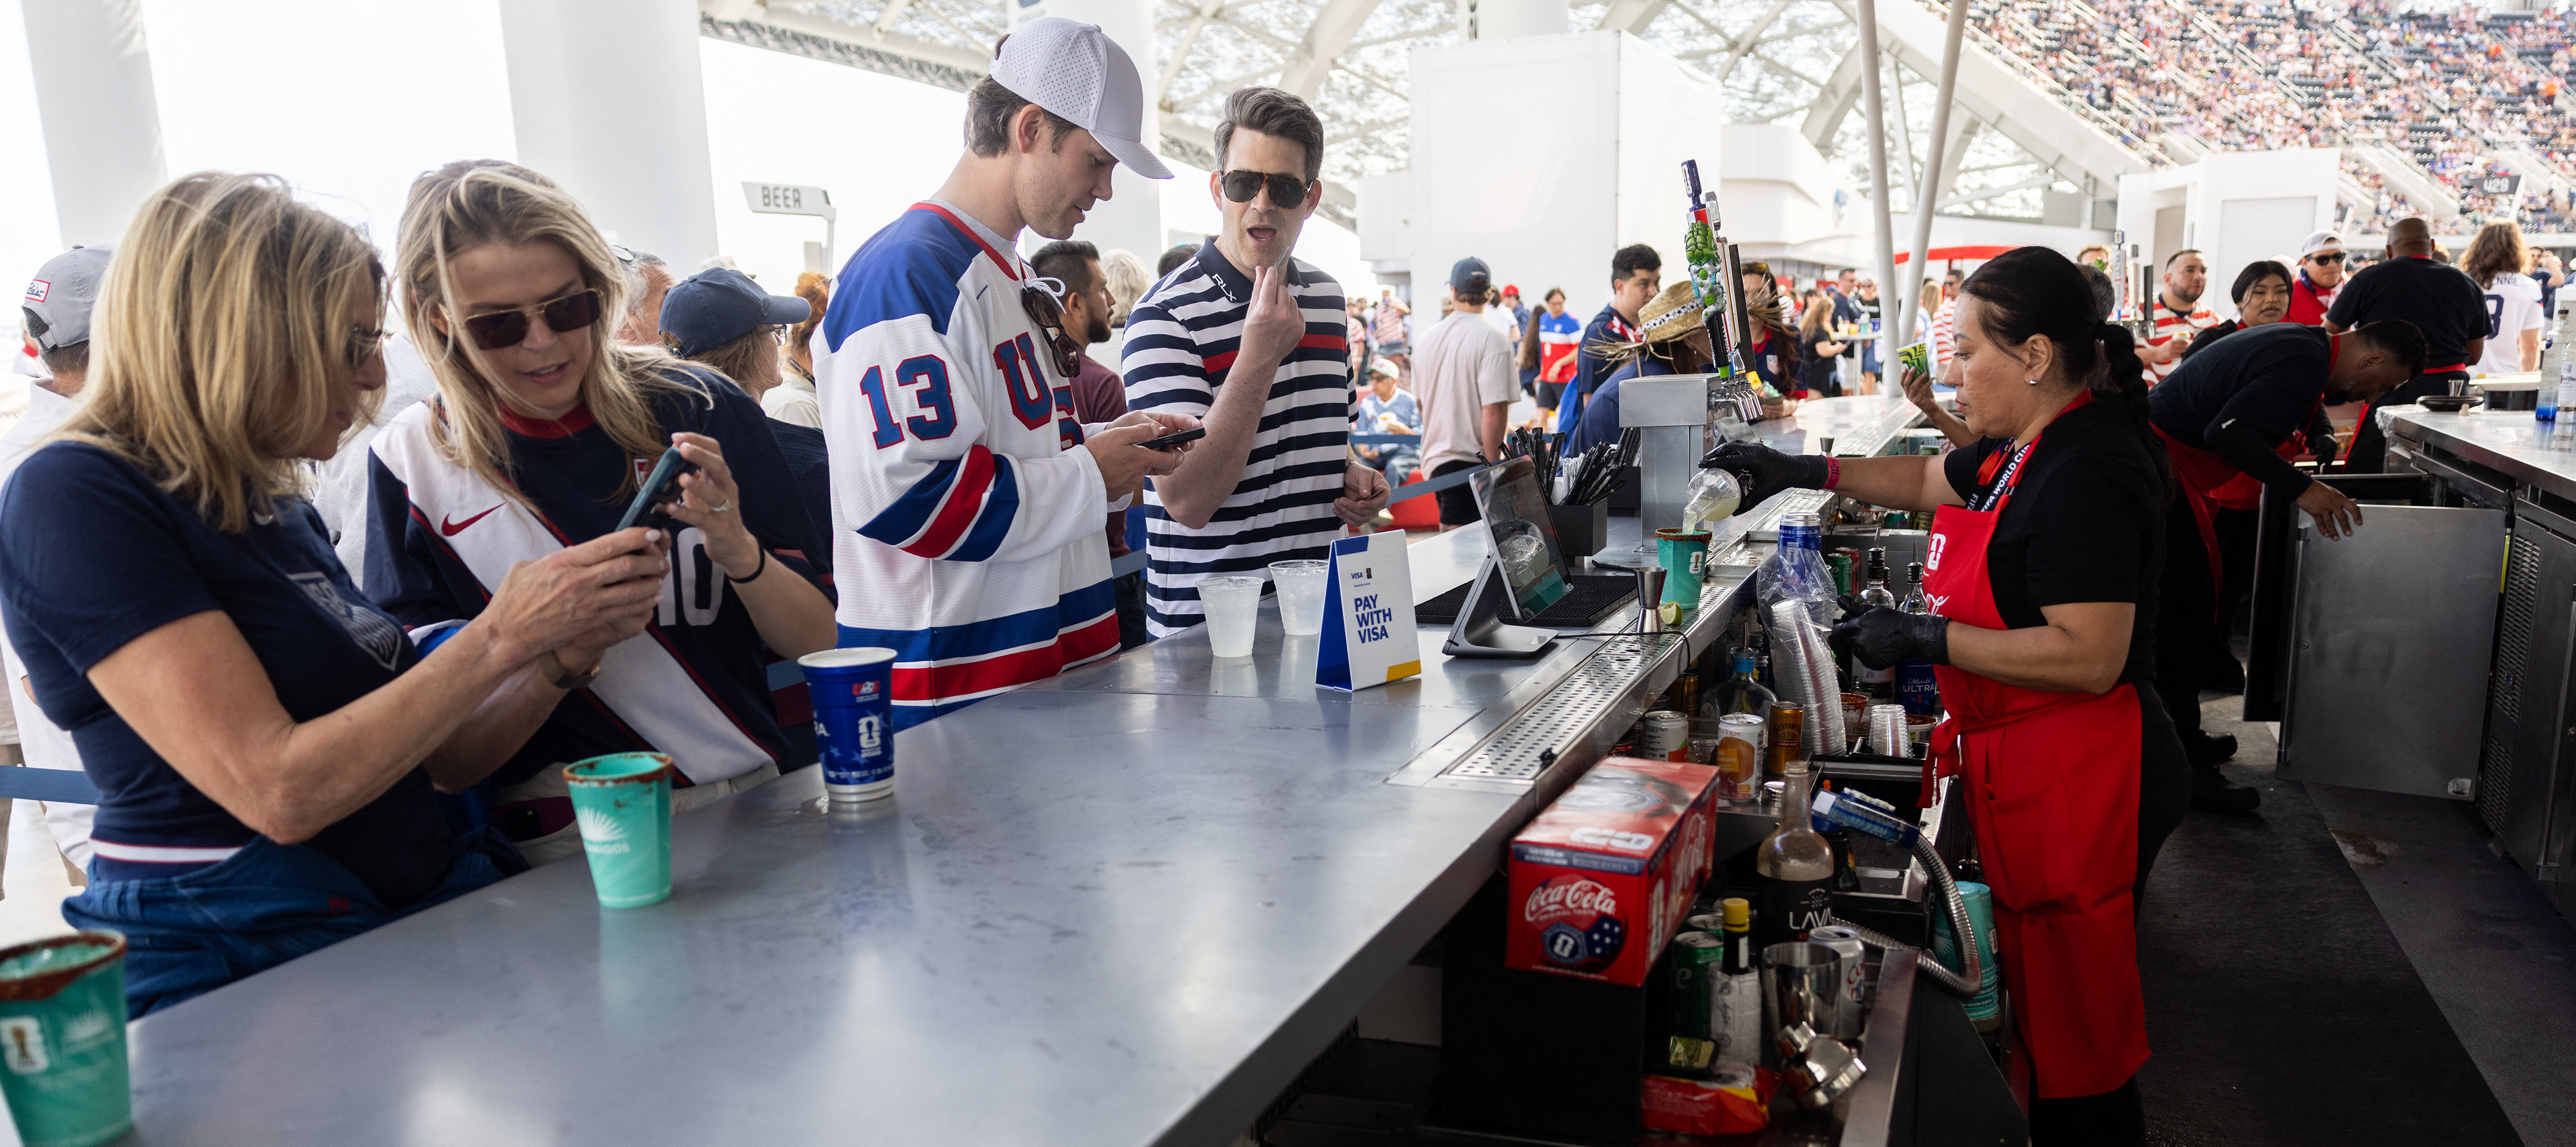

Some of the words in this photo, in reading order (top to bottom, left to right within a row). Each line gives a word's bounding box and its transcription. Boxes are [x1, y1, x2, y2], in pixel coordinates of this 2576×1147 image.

[762, 186, 801, 209] BEER
[1212, 273, 1237, 301] RLX
[859, 353, 958, 450] 13
[1993, 462, 2017, 495] WORLD
[1981, 495, 1995, 512] FIFA
[1354, 594, 1378, 612] PAY
[1356, 607, 1392, 628] WITH
[1357, 625, 1389, 644] VISA
[1903, 683, 1935, 692] ULTRA
